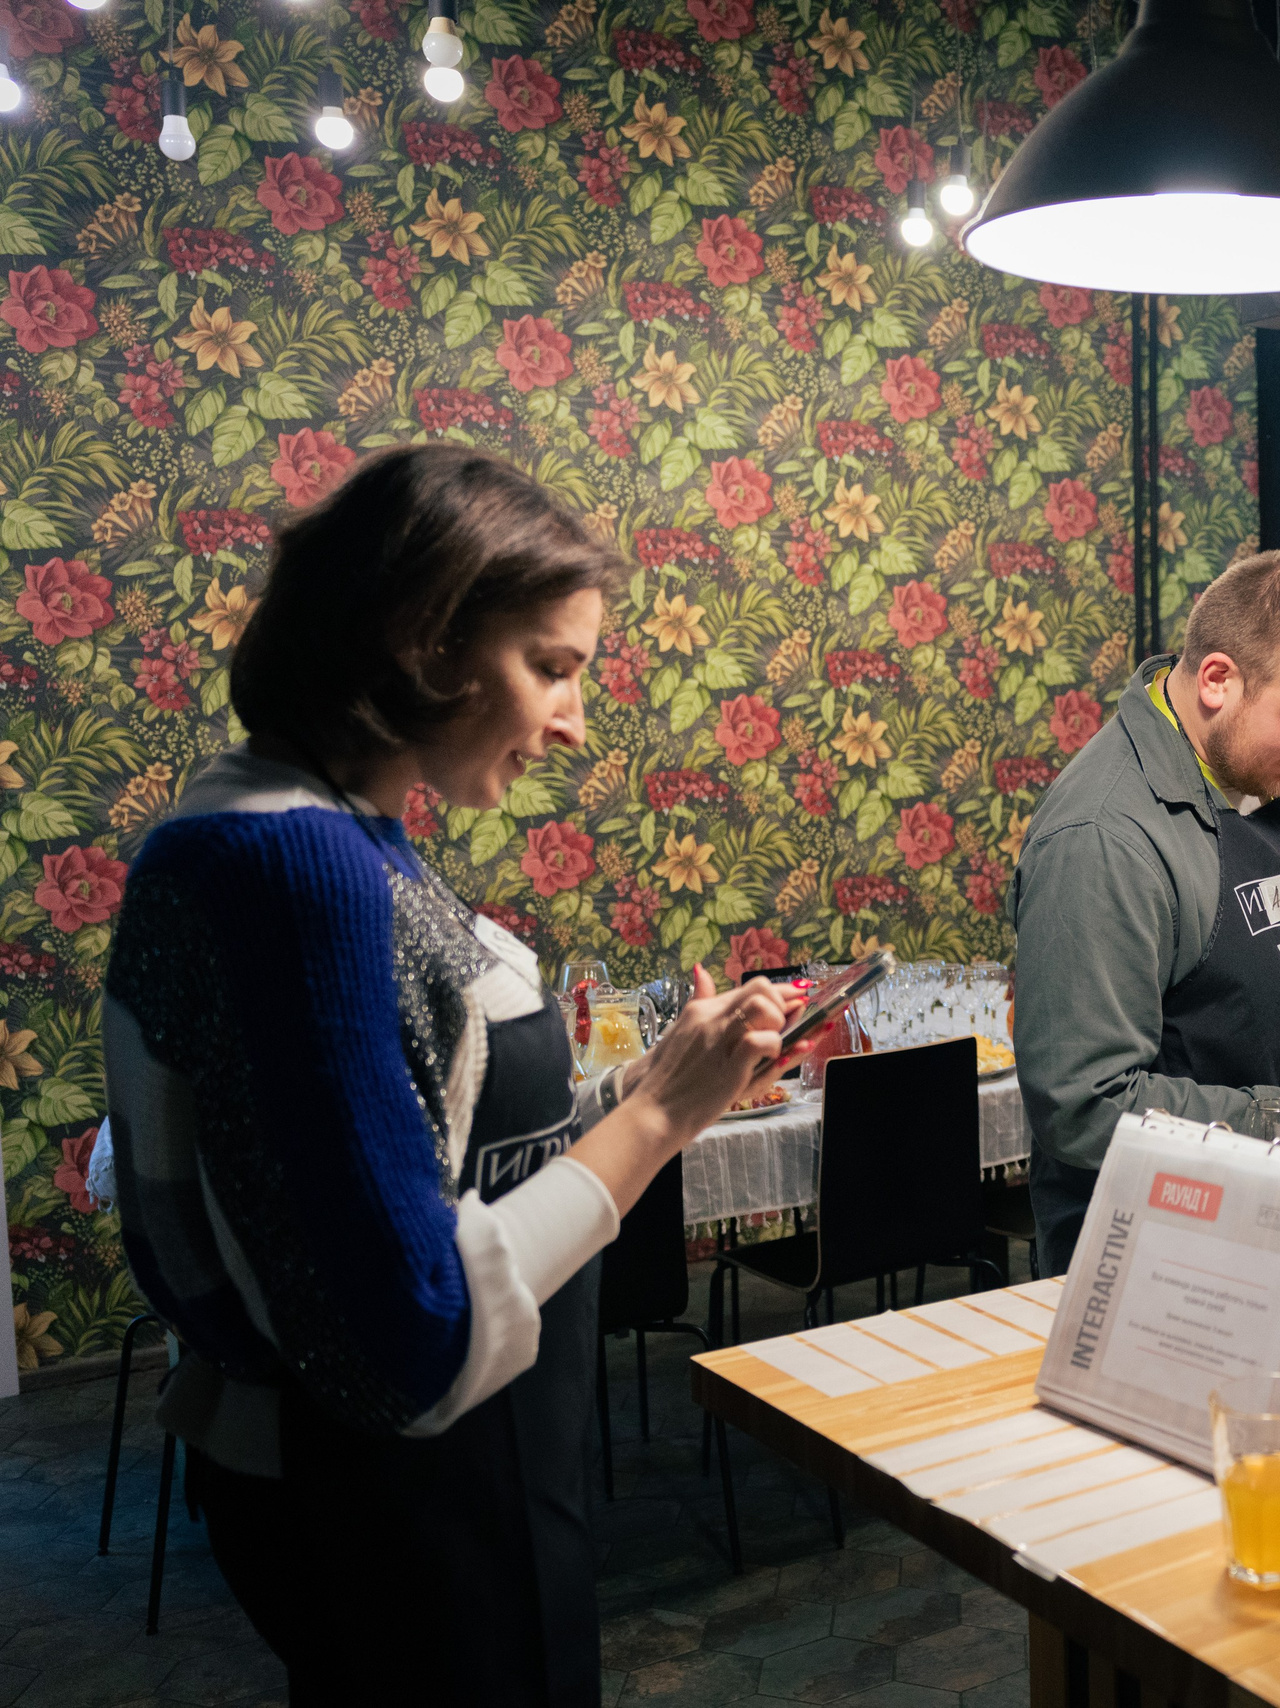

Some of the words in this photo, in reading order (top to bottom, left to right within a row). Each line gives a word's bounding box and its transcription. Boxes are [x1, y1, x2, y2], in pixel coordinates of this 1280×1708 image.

[1160, 1181, 1202, 1214] РАУНД
[1201, 1190, 1211, 1213] 1
[1069, 1208, 1135, 1371] INTERACTIVE
